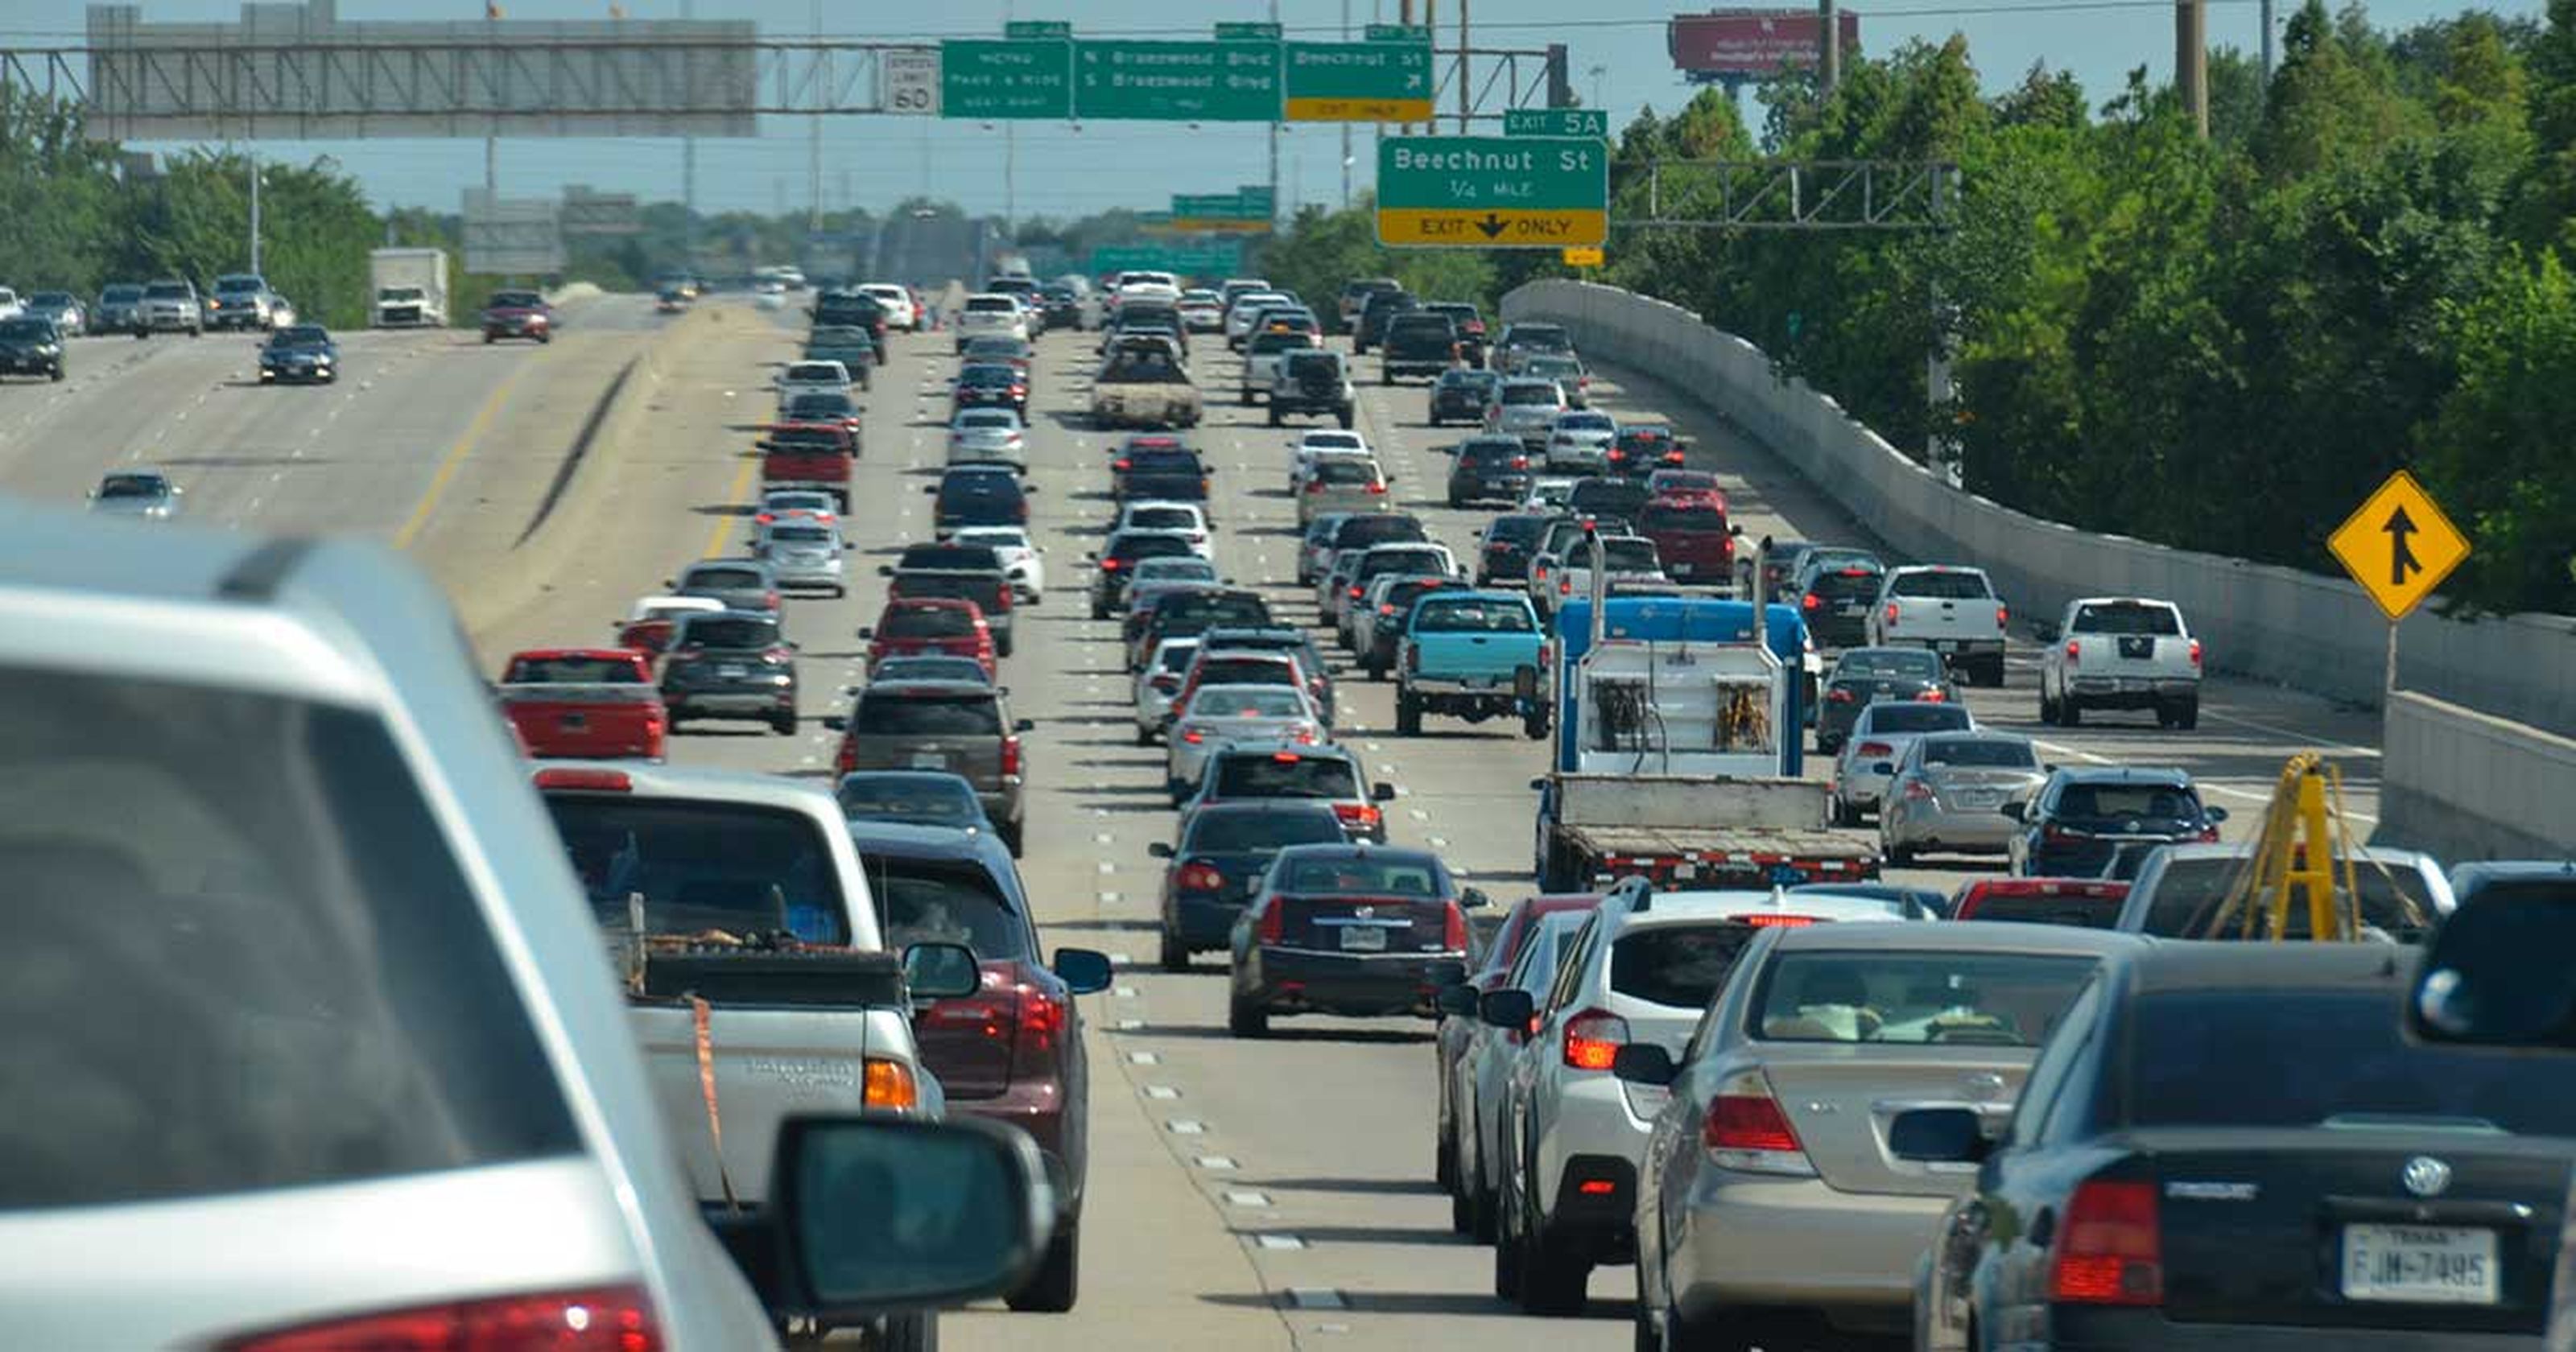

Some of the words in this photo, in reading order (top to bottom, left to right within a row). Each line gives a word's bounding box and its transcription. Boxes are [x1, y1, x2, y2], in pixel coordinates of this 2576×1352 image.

[1084, 51, 1097, 64] N
[1085, 73, 1096, 86] S
[894, 88, 929, 109] 60
[1510, 114, 1546, 129] EXIT
[1565, 114, 1600, 134] 5A
[1394, 147, 1534, 170] Beechnut
[1559, 150, 1590, 171] St
[1421, 217, 1465, 236] EXIT
[1517, 217, 1573, 236] ONLY
